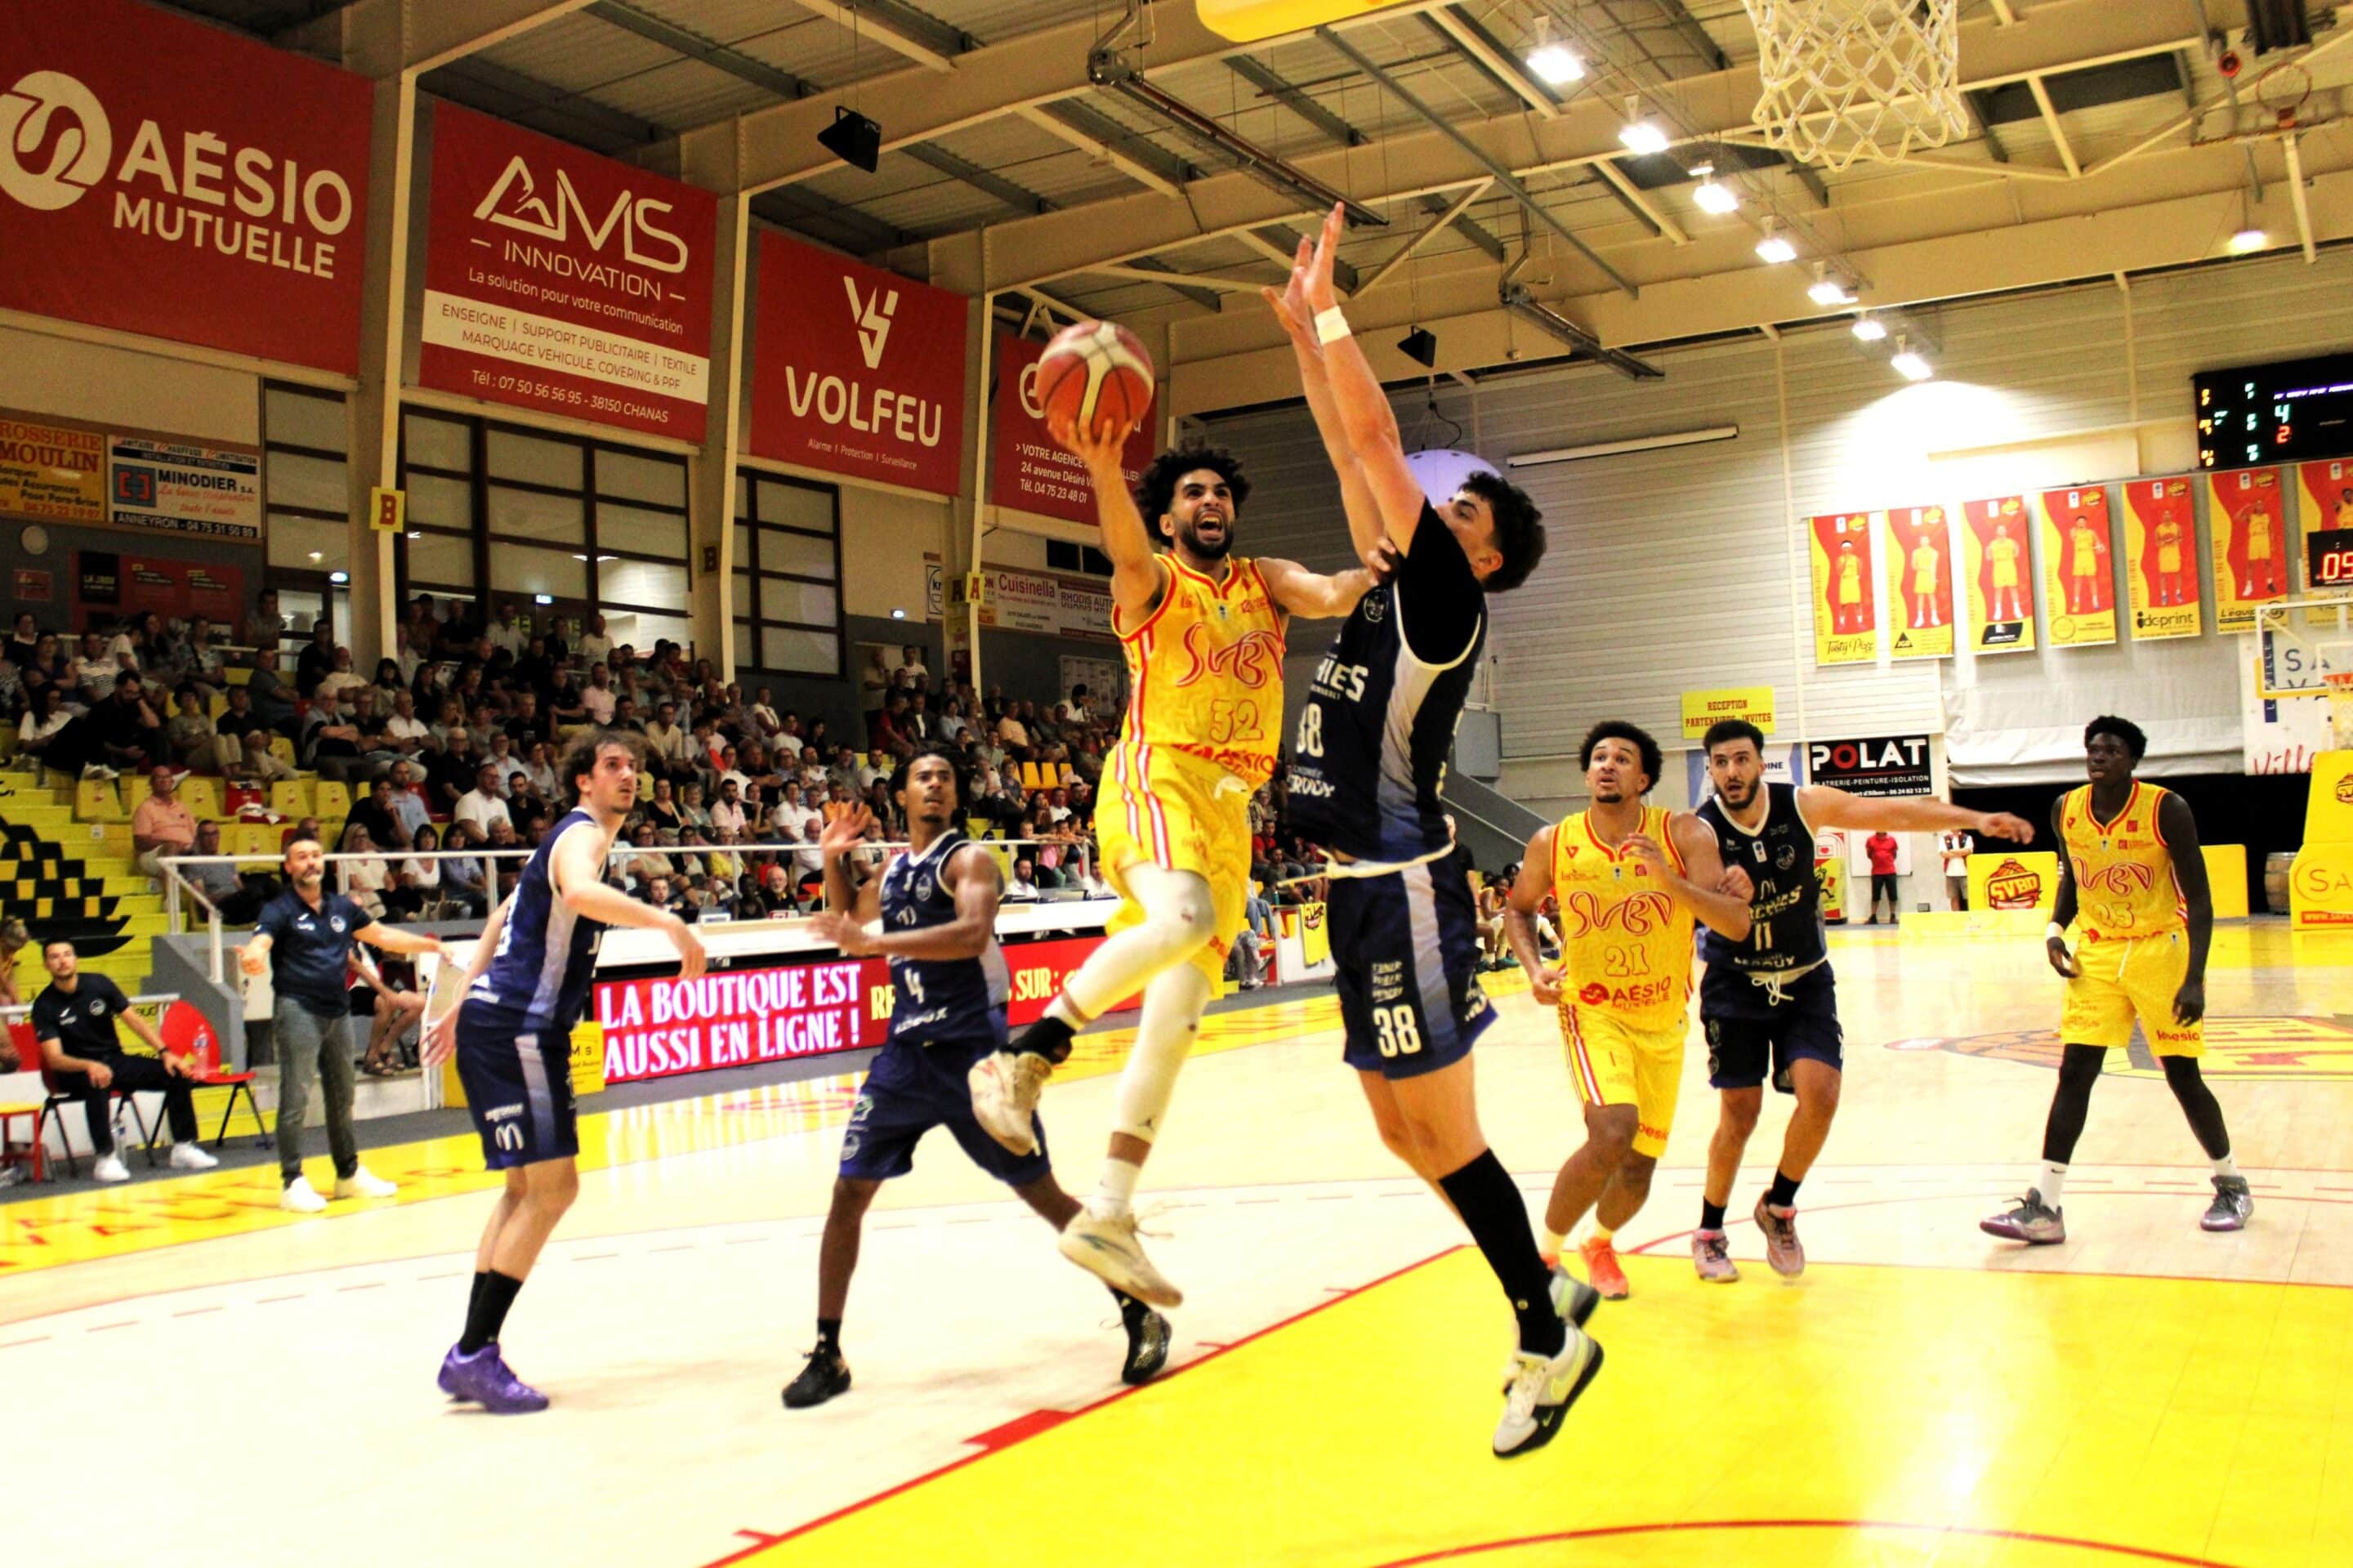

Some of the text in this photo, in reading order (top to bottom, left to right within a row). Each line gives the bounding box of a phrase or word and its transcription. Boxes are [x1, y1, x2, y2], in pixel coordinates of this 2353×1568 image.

[117, 119, 352, 235] AÉSIO
[472, 155, 689, 273] AMS
[114, 191, 335, 279] MUTUELLE
[504, 239, 661, 301] INNOVATION
[468, 267, 683, 334] La solution pour votre communication
[442, 303, 507, 330] ENSEIGNE
[522, 322, 577, 346] SUPPORT
[579, 336, 650, 364] PUBLICITAIRE
[663, 355, 697, 376] TEXTILE
[462, 330, 681, 390] MARQUAGE VEHICULE, COVERING & PPF
[499, 374, 515, 390] 07
[517, 378, 533, 395] 50
[534, 382, 549, 399] 56
[551, 386, 565, 402] 56
[568, 389, 582, 405] 95
[591, 395, 621, 413] 38150
[623, 402, 669, 423] CHANAS
[785, 365, 942, 448] VOLFEU
[808, 438, 833, 452] Alarme
[841, 444, 873, 462] Protection
[882, 453, 918, 470] Surveillance
[1022, 444, 1050, 460] VOTRE
[1051, 451, 1083, 468] AGENCE
[159, 470, 236, 491] MINODIER
[1021, 461, 1032, 473] 24
[1034, 465, 1061, 480] avenue
[1063, 471, 1085, 485] Désiré
[1034, 481, 1047, 494] 04
[1047, 484, 1056, 496] 75
[1057, 487, 1067, 499] 23
[1068, 489, 1078, 501] 48
[379, 494, 396, 525] B
[970, 578, 980, 600] A
[999, 574, 1056, 597] Cuisinella
[1209, 699, 1265, 744] 32
[1707, 699, 1748, 711] RECEPTION
[1811, 739, 1927, 771] POLAT
[1990, 876, 2038, 900] SVBD
[2092, 901, 2136, 929] 23
[1755, 922, 1773, 951] 11
[1605, 943, 1650, 977] 21
[601, 985, 643, 1030] LA
[651, 965, 813, 1025] BOUTIQUE
[819, 963, 861, 1004] EST
[904, 968, 924, 1004] 4
[603, 1029, 701, 1079] AUSSI
[712, 1024, 748, 1064] EN
[758, 1008, 842, 1056] LIGNE
[1373, 1004, 1422, 1058] 38
